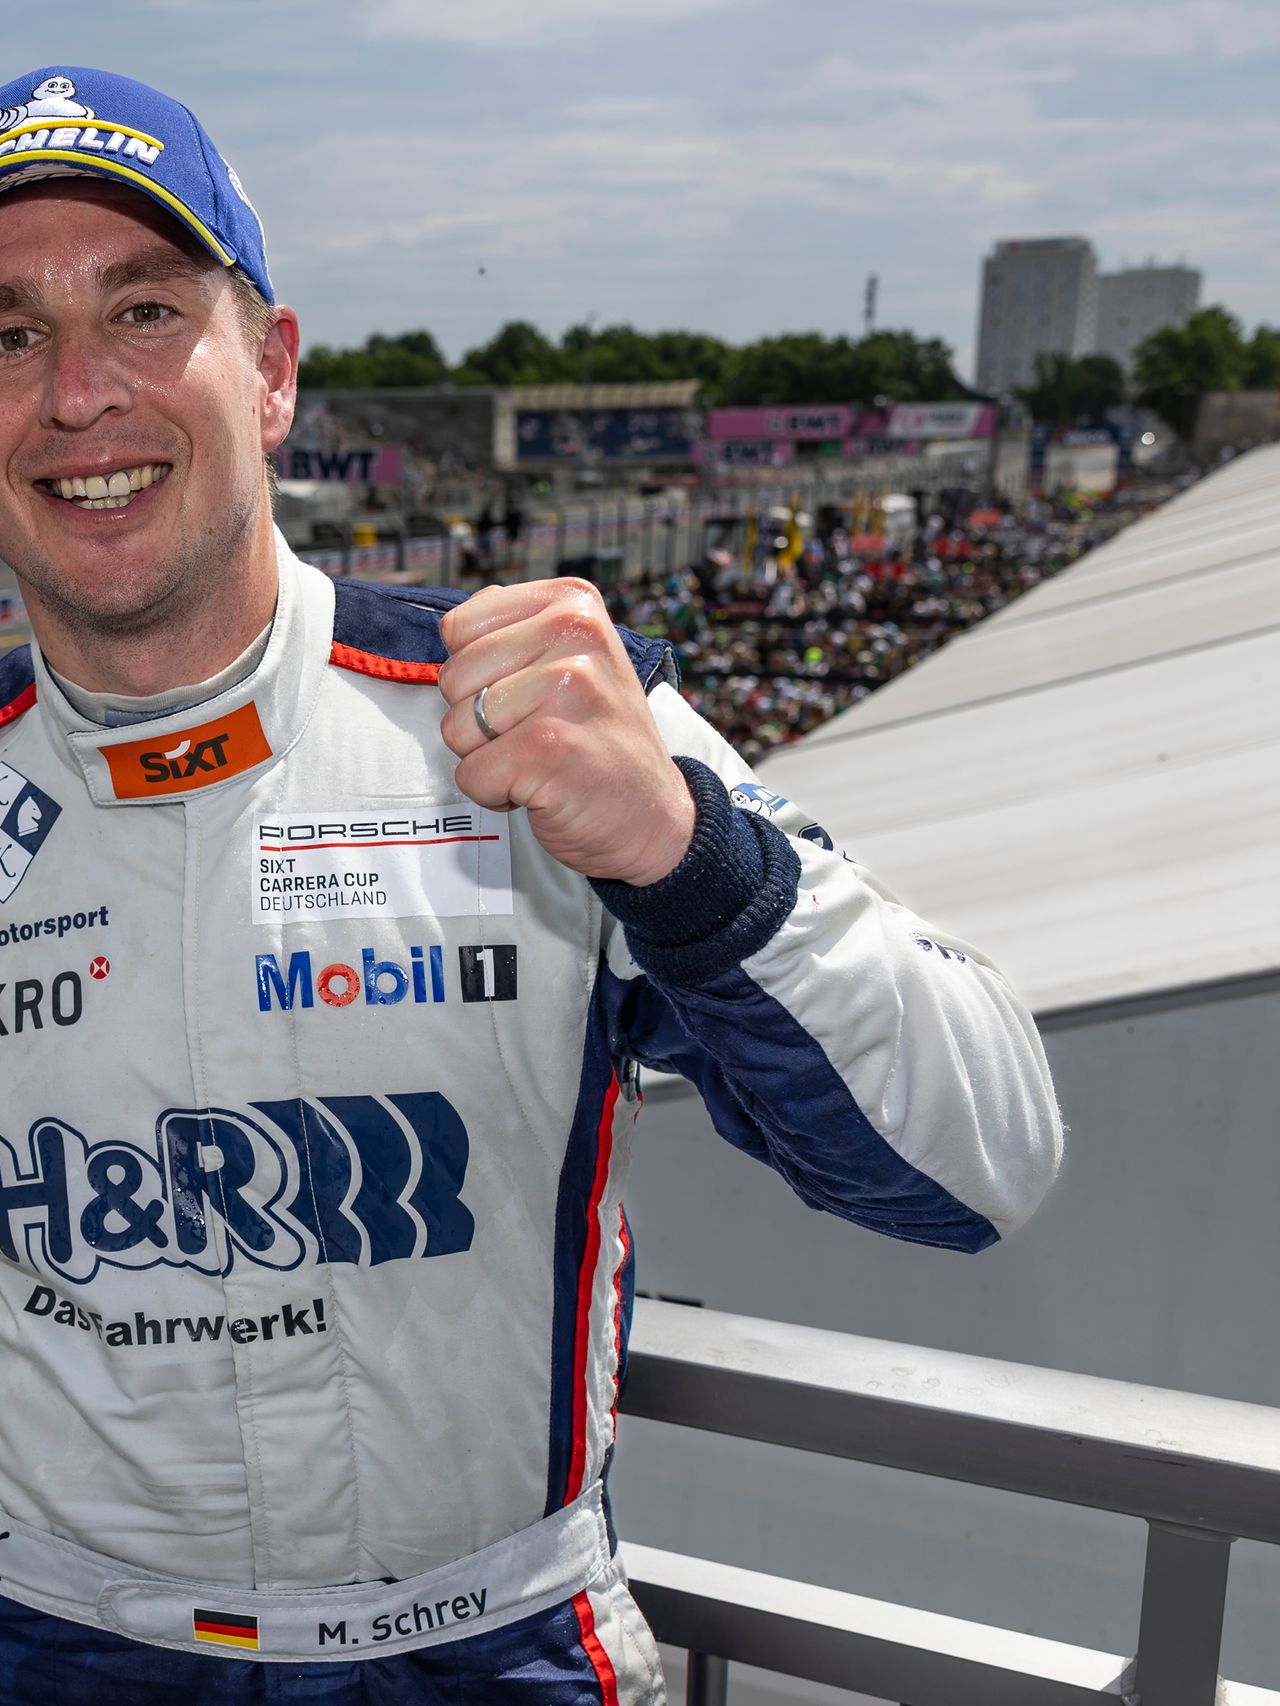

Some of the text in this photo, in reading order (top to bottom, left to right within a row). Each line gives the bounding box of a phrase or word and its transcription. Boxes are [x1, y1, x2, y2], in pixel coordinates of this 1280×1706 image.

[292, 449, 373, 480] BWT
[258, 815, 472, 841] PORSCHE
[259, 858, 296, 874] SIXT
[259, 872, 379, 893] CARRERA CUP
[260, 891, 387, 911] DEUTSCHLAND
[255, 945, 496, 1012] Mobil 1
[24, 1285, 328, 1348] Das Fahrwerk!
[318, 1587, 488, 1646] M. Schrey
